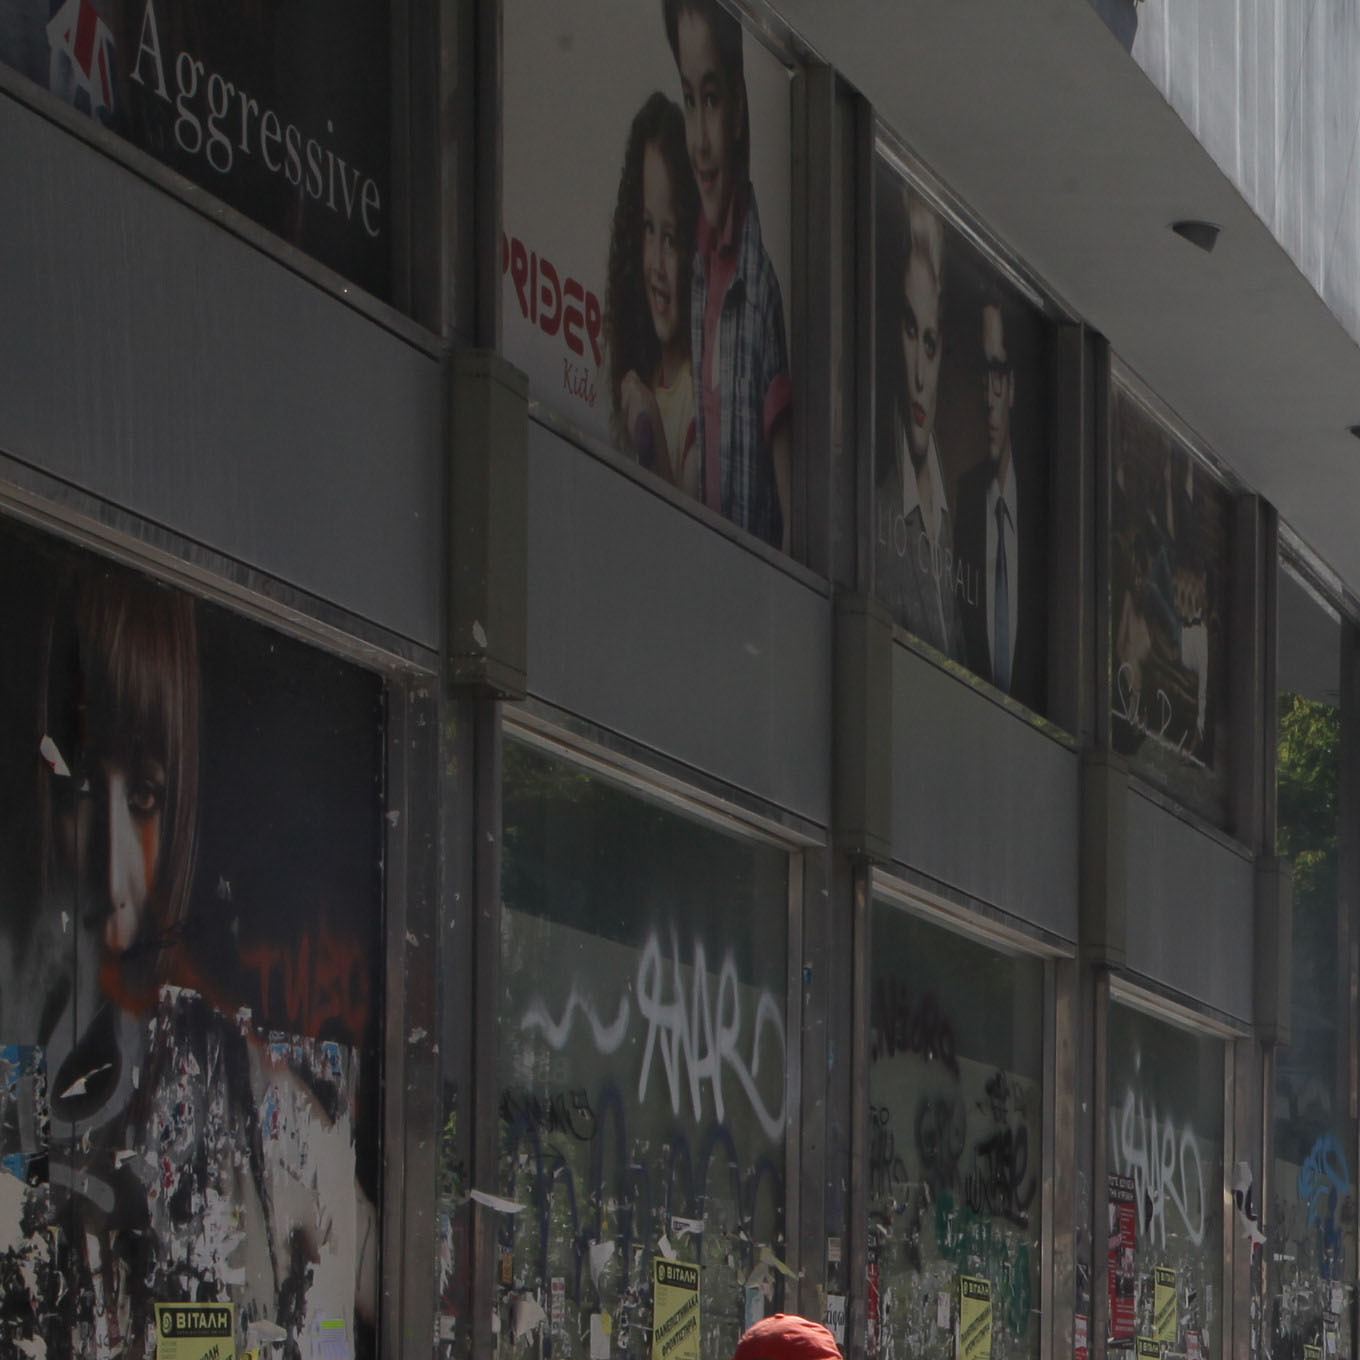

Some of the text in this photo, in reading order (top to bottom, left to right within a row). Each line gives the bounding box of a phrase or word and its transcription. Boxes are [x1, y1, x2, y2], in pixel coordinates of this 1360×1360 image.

[130, 0, 382, 237] Aggressive
[562, 358, 598, 407] Kids
[176, 1312, 228, 1329] ΒΙΤΑΛΗ
